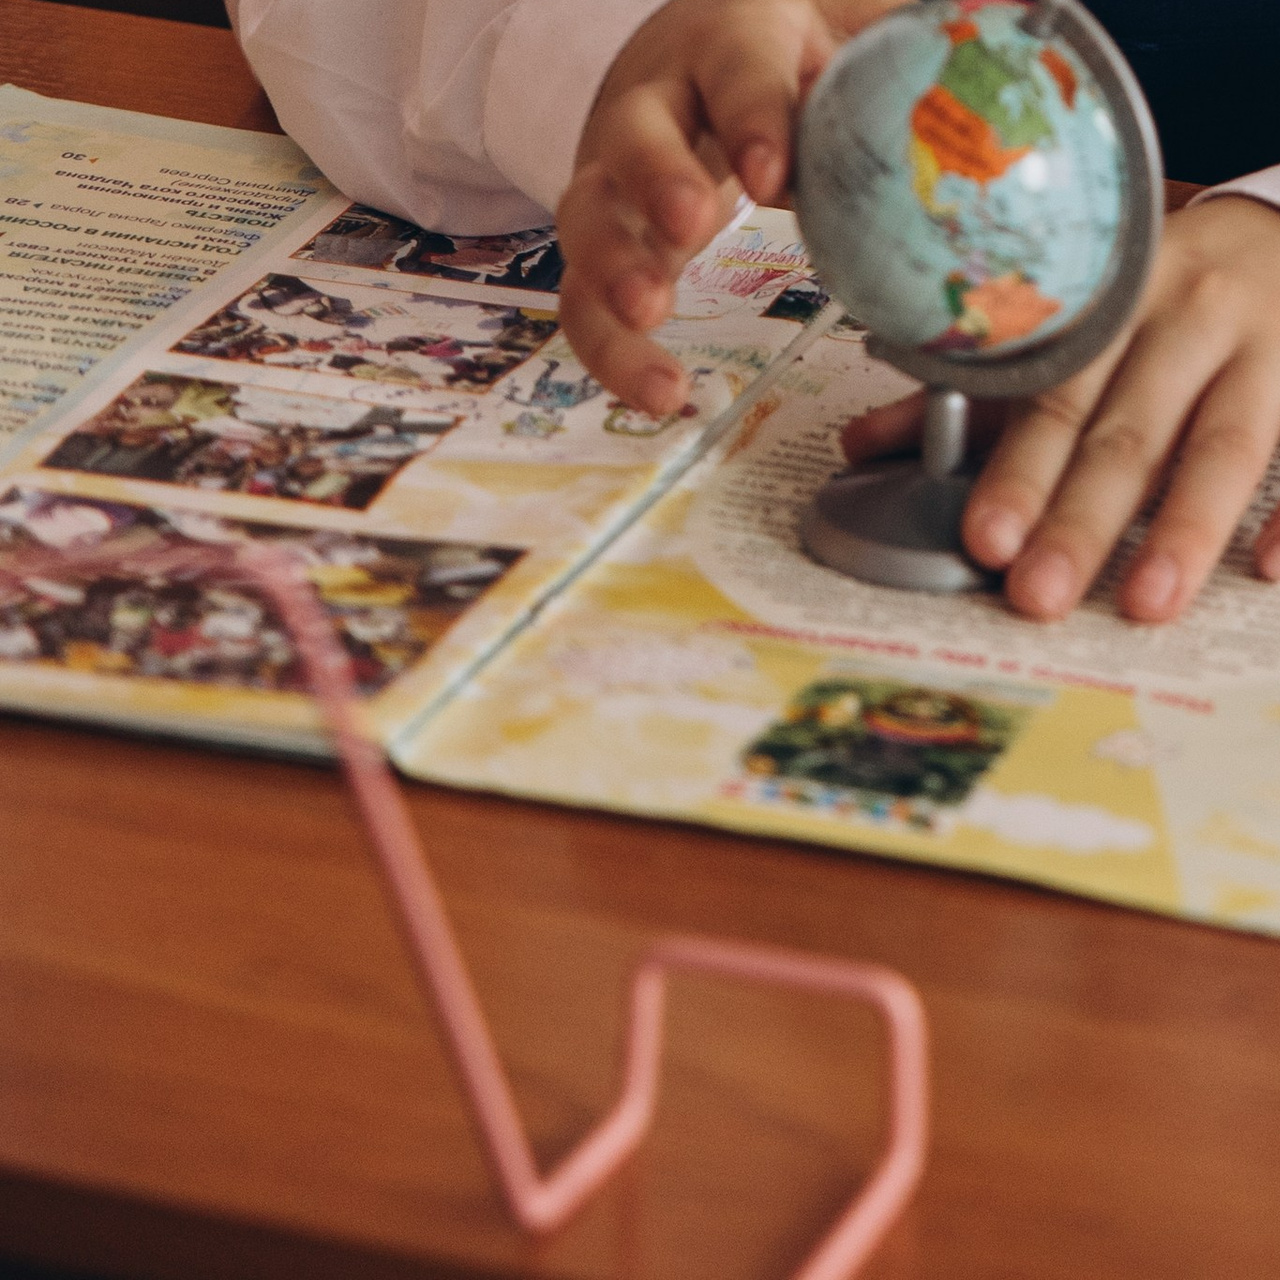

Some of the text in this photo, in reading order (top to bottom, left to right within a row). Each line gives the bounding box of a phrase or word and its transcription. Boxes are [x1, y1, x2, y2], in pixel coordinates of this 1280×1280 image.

[61, 151, 87, 161] 30
[55, 170, 295, 212] сибирского кота Чалдона
[159, 168, 317, 197] Дмитрий Сергеев
[77, 184, 205, 207] приключения
[171, 179, 307, 205] (продолжение)
[4, 197, 262, 241] Федерико Гарсиа Лорка 28
[185, 210, 276, 228] ПОВЕСТЬ
[225, 206, 286, 221] Жизнь
[0, 215, 81, 232] РОССИИ
[4, 242, 50, 251] свет
[101, 231, 198, 250] ИСПАНИИ
[194, 235, 252, 248] Стихи
[51, 248, 137, 264] тускнеет
[77, 242, 157, 259] Мадасон
[201, 244, 242, 256] ГОД
[8, 251, 207, 283] ЮБИЛЕЙ ПИСАТЕЛЯ
[143, 261, 199, 272] степи
